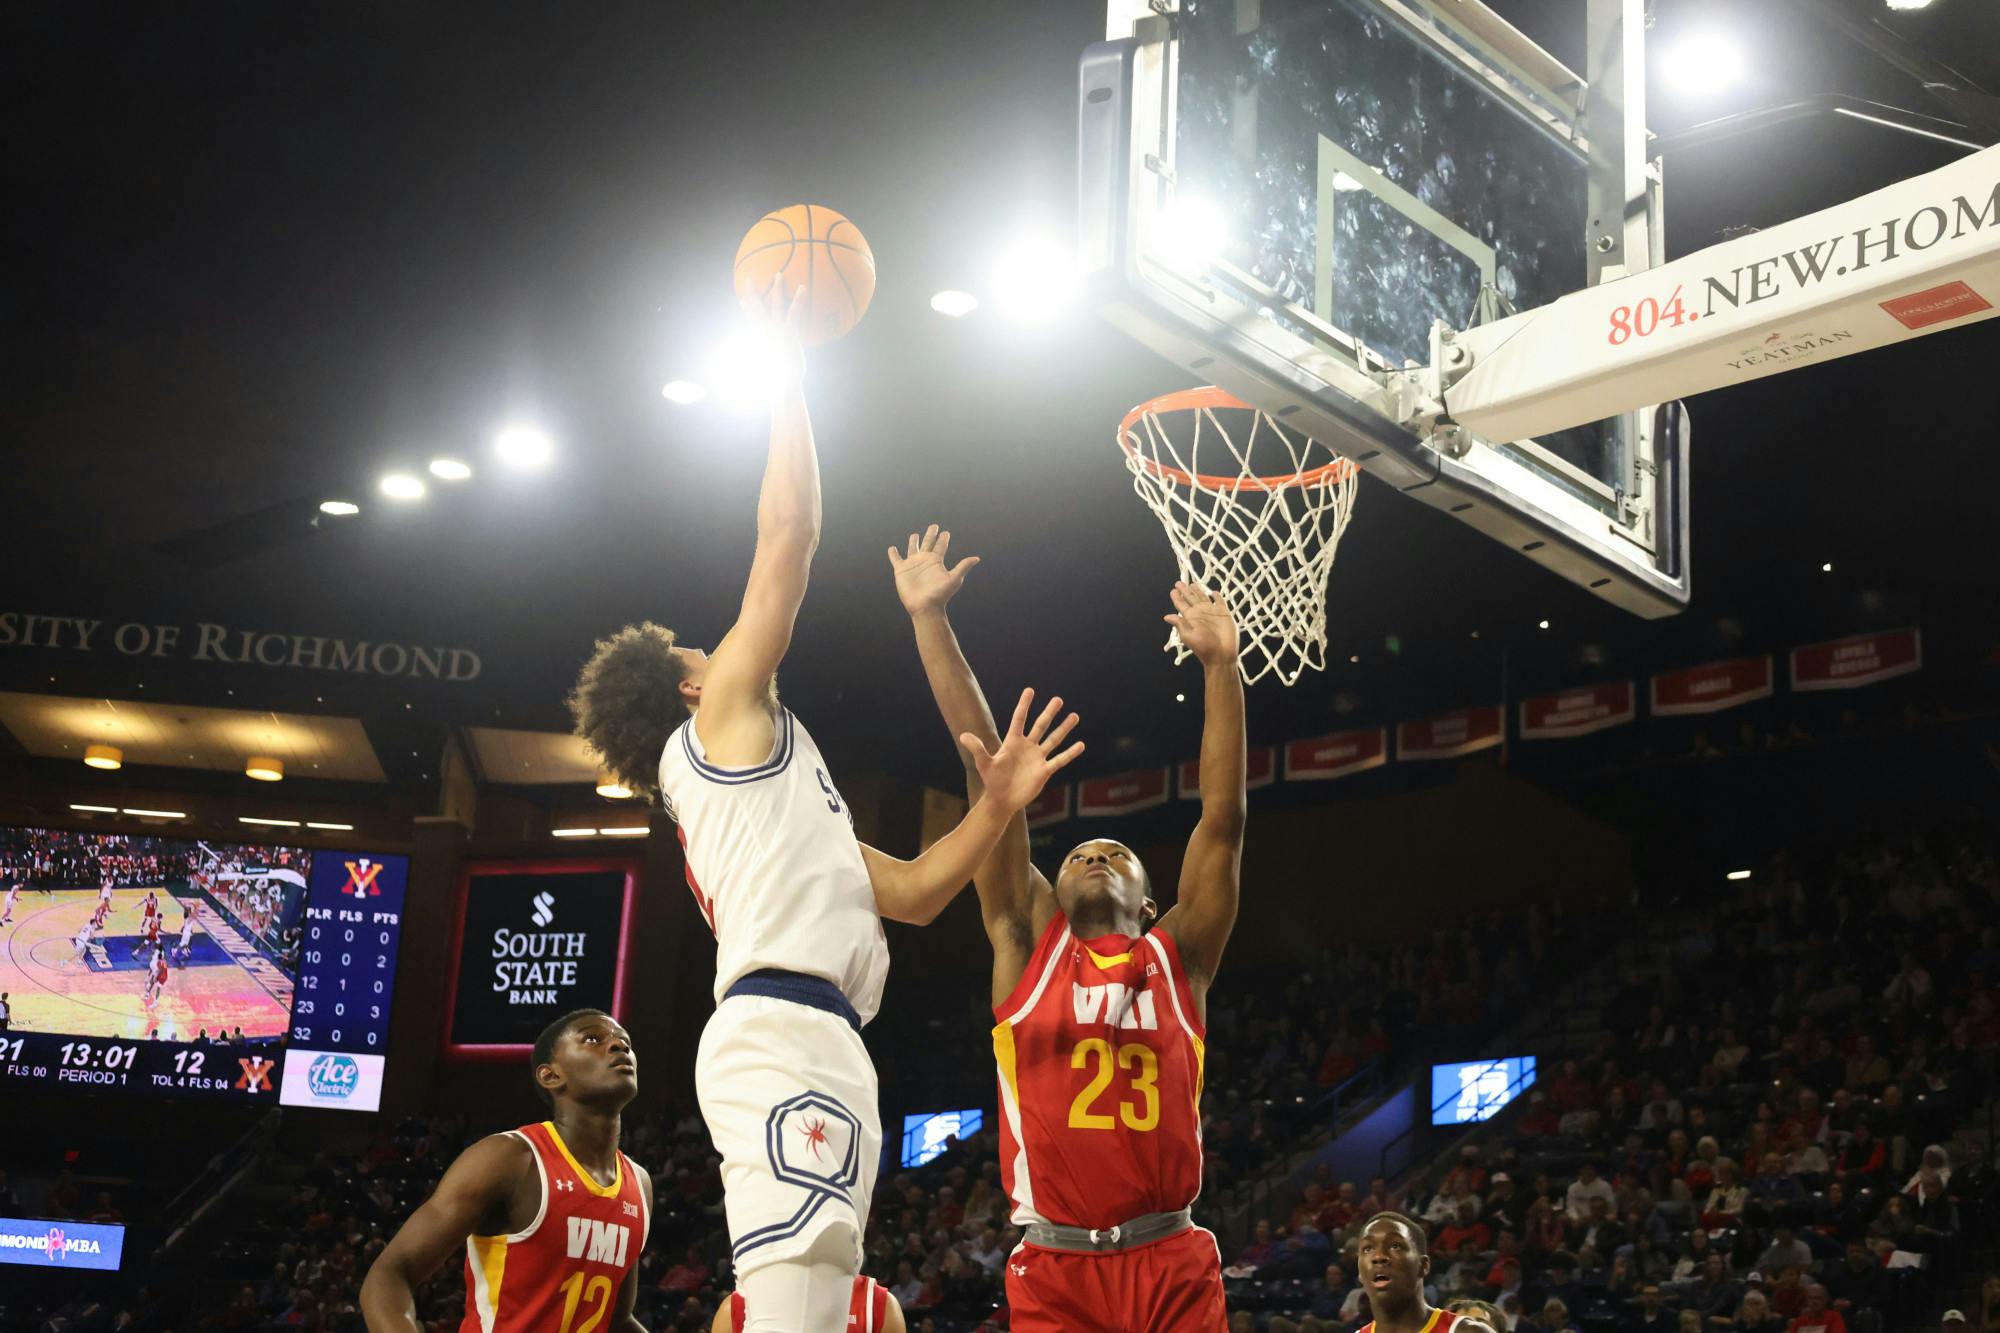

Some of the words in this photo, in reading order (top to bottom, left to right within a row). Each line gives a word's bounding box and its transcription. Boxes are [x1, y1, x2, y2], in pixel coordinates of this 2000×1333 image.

[1608, 182, 2000, 346] 804.NEW.HOM
[1727, 330, 1853, 369] YEATMAN
[0, 612, 103, 651] SITY
[114, 622, 181, 657] OF
[192, 622, 482, 681] RICHMOND
[306, 907, 332, 920] PLR
[339, 910, 363, 922] FLS
[373, 912, 398, 925] PTS
[311, 927, 320, 940] 0
[344, 929, 354, 942] 0
[380, 931, 390, 945] 0
[492, 928, 586, 959] SOUTH
[305, 951, 321, 964] 10
[341, 953, 351, 966] 0
[377, 955, 386, 968] 2
[302, 975, 318, 989] 12
[339, 979, 346, 991] 1
[373, 981, 383, 994] 0
[493, 961, 577, 992] STATE
[297, 1000, 314, 1014] 23
[335, 1003, 344, 1016] 0
[370, 1005, 380, 1019] 3
[509, 990, 558, 1004] BANK
[293, 1026, 311, 1041] 32
[331, 1029, 341, 1043] 0
[367, 1032, 377, 1045] 0
[0, 1037, 24, 1062] 21
[61, 1042, 138, 1070] 13:01
[7, 1064, 30, 1076] FLS
[33, 1066, 47, 1078] 00
[174, 1050, 206, 1075] 12
[311, 1056, 356, 1085] Ace
[59, 1068, 116, 1085] PERIOD
[120, 1073, 128, 1086] 1
[152, 1074, 174, 1087] TOL
[177, 1077, 185, 1087] 4
[189, 1078, 211, 1090] FLS
[215, 1079, 228, 1091] 04
[1068, 1038, 1160, 1132] 23
[65, 1238, 100, 1254] MBA
[567, 1216, 630, 1267] VMI
[559, 1271, 612, 1333] 12
